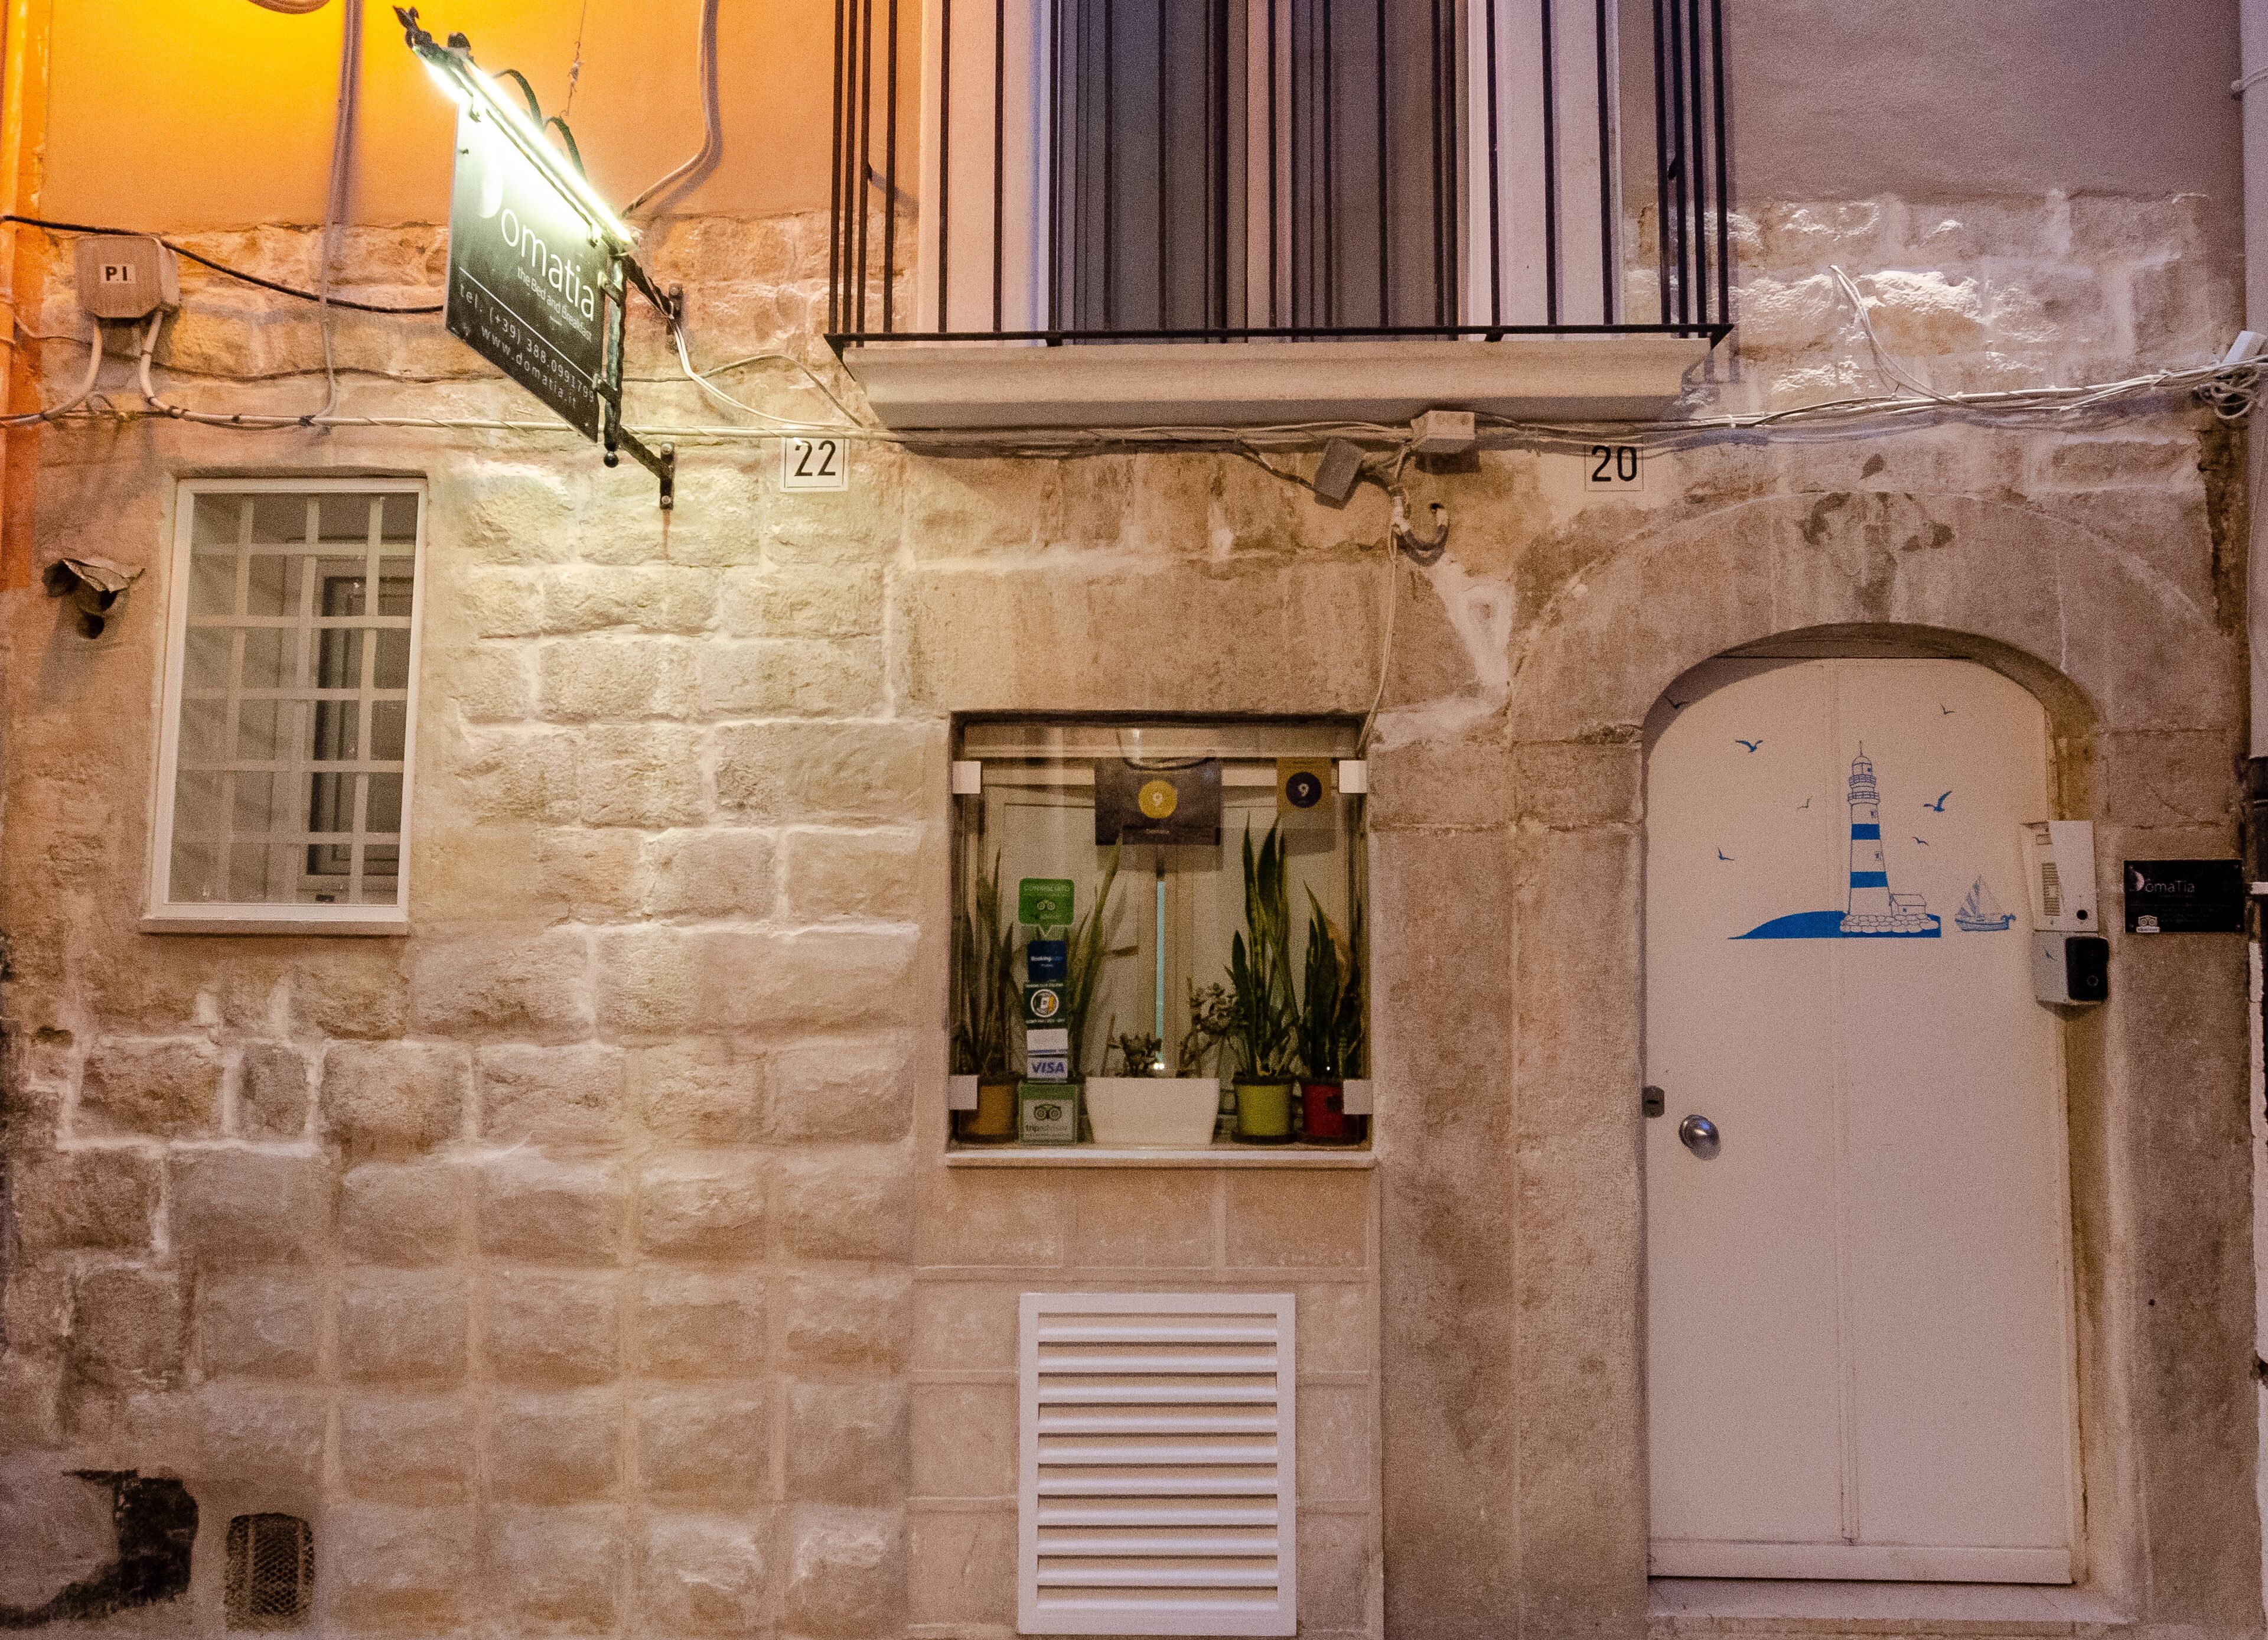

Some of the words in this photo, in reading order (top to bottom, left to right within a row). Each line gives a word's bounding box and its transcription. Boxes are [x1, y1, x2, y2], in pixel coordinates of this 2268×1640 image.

[517, 266, 530, 287] the
[531, 277, 546, 301] Bed
[546, 295, 561, 314] and
[481, 326, 577, 409] www.domatia.it
[794, 440, 836, 477] 22
[1591, 444, 1637, 482] 20
[1032, 1062, 1064, 1073] VISA
